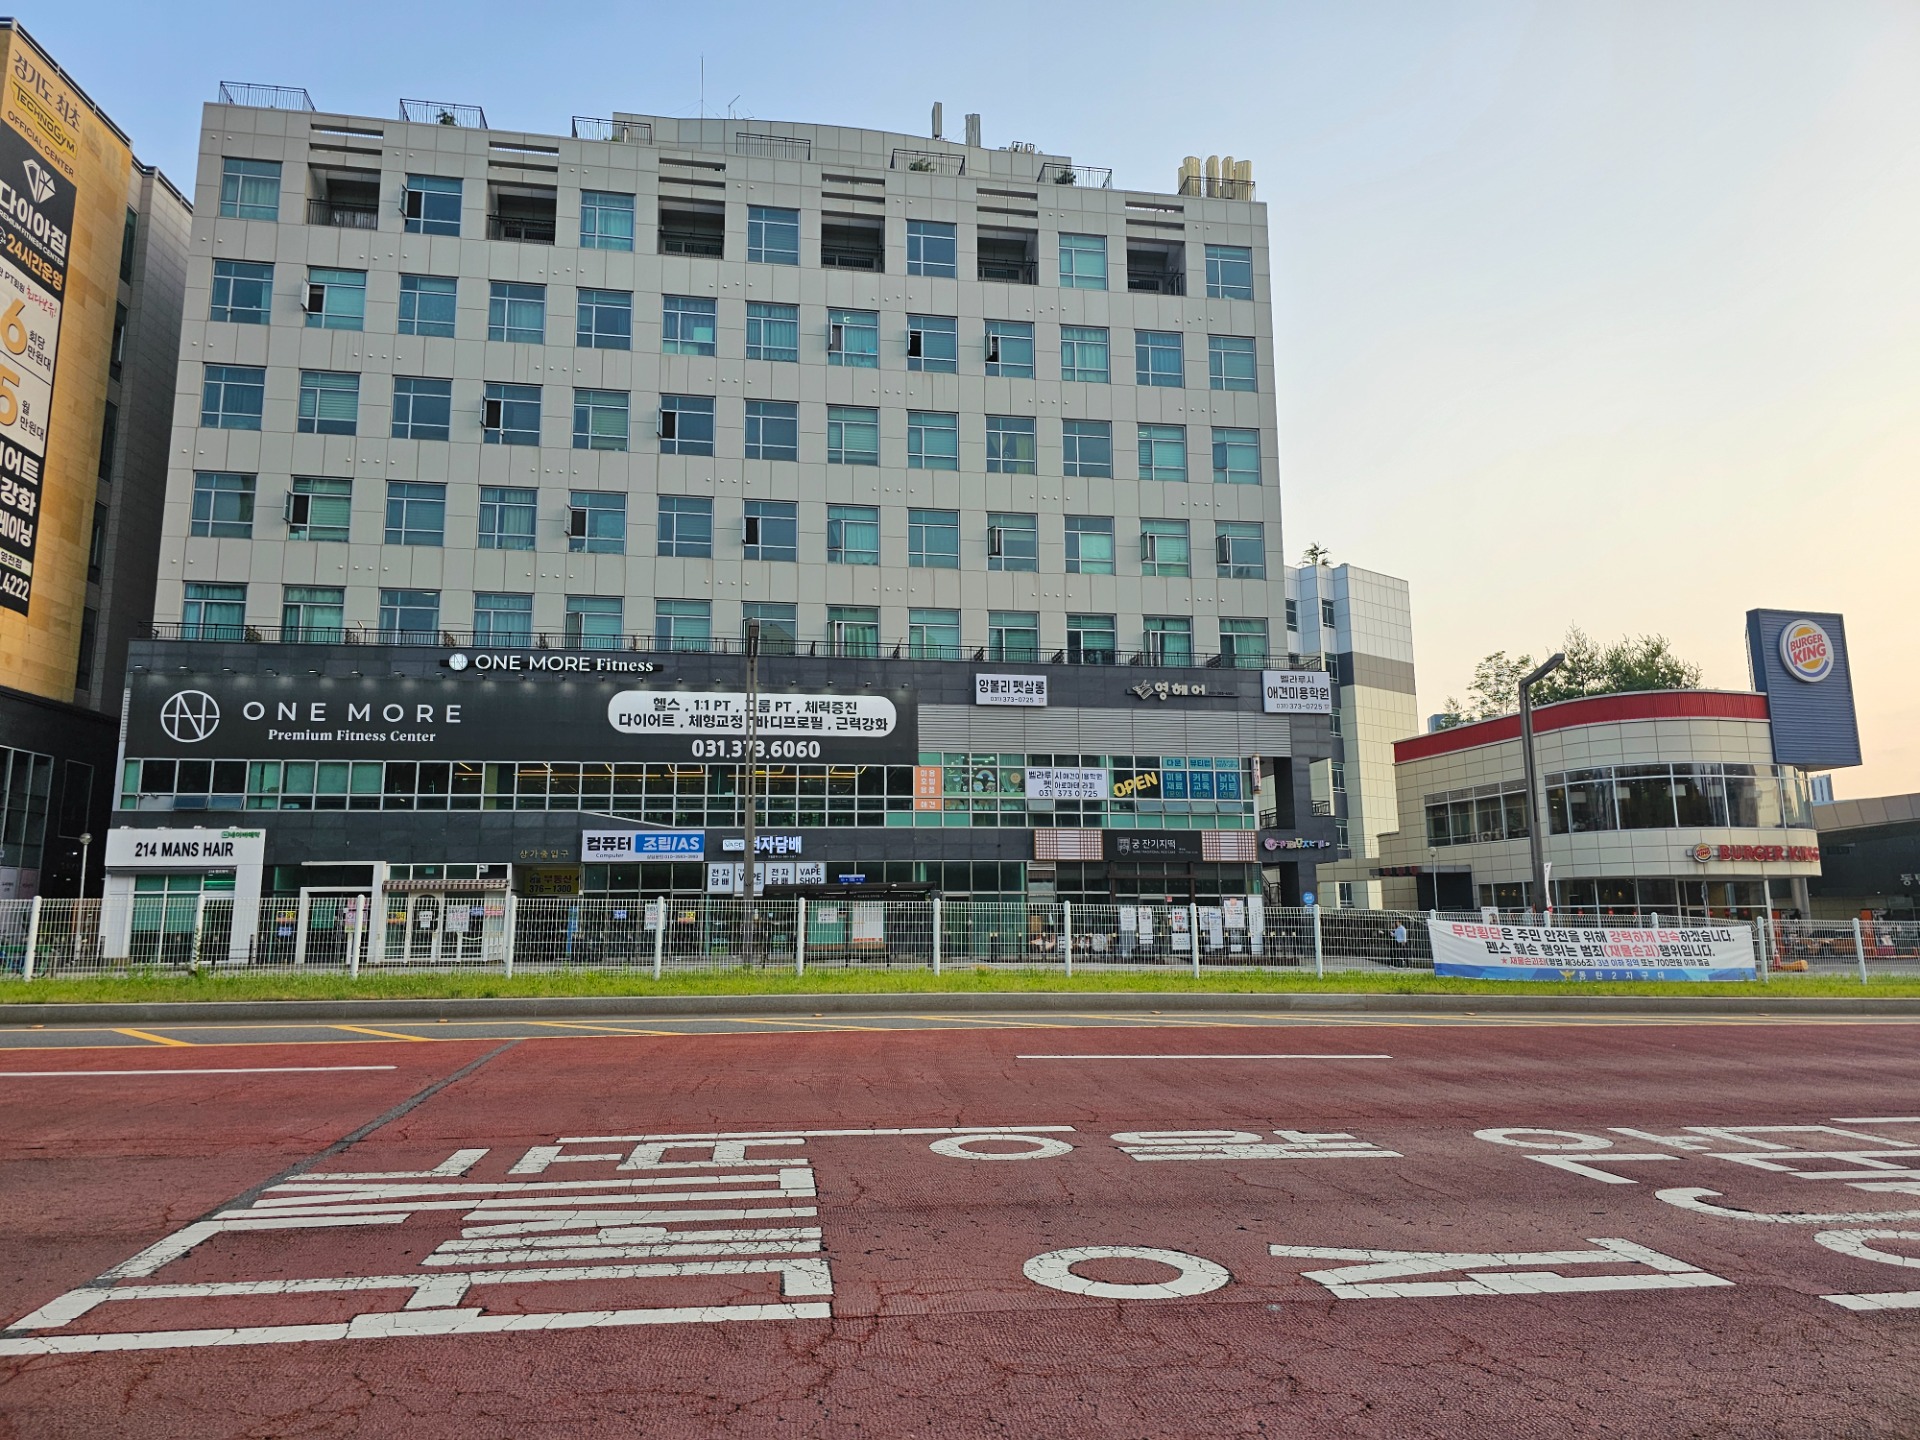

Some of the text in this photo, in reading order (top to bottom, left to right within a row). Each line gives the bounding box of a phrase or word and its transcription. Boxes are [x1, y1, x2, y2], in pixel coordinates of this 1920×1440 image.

[13, 49, 81, 133] 경기도 최초
[7, 110, 74, 178] OFFICIAL CENTER
[0, 179, 68, 258] 다이아짐
[0, 208, 65, 268] REMIUM FITNESS CENTER
[6, 233, 64, 291] 24시간운영
[29, 330, 45, 350] 회당
[27, 345, 52, 372] 만원대
[20, 415, 44, 441] 만원대
[1790, 634, 1823, 651] BURGER
[1793, 642, 1826, 665] KING
[475, 654, 653, 672] ONE MORE Fitness
[1013, 680, 1045, 695] 펫살롱
[1280, 675, 1315, 684] 벨라루시
[1155, 682, 1206, 700] 영헤어
[1267, 686, 1330, 700] 애견미용학원
[243, 701, 462, 723] ONE MORE
[653, 697, 680, 712] 헬스
[693, 700, 710, 711] 1:1
[713, 700, 731, 712] PT
[775, 701, 792, 713] PT
[805, 700, 858, 715] 체력증진
[618, 713, 888, 731] 다이어트 체형교정 바디프로필 근력강화
[268, 728, 436, 742] Premium Fitness Center
[1113, 771, 1158, 797] OPEN
[1166, 773, 1183, 781] 미용
[1192, 774, 1210, 782] 커트
[1219, 782, 1237, 791] 커트
[135, 842, 234, 857] 214 MANS HAIR
[587, 836, 700, 851] 컴퓨터 조립/AS
[1131, 838, 1176, 849] 궁 잔기지떡
[1718, 845, 1820, 862] BURGER KING
[543, 875, 572, 883] 부동산
[711, 868, 730, 877] 전자
[771, 868, 789, 877] 전자
[800, 868, 821, 876] VAPE
[528, 885, 572, 893] 376-1300
[711, 877, 730, 886] 담배
[1452, 923, 1735, 943] 무단횡단은 주민 안전을 위해 강력하게 단속하겠습니다.
[1485, 941, 1511, 954] 펜스
[1541, 943, 1578, 957] 행위는
[1580, 943, 1715, 957] 범죄(재물손괴)행위입니다.
[1565, 957, 1596, 967] 제366조)
[1598, 959, 1610, 967] 3년
[1611, 959, 1625, 967] 이하
[1626, 959, 1641, 967] 징역
[1641, 959, 1656, 967] 또는
[1657, 959, 1683, 967] 700만원
[1684, 959, 1696, 967] 이하
[1697, 959, 1710, 967] 벌금
[1578, 971, 1665, 980] 동탄2지구대
